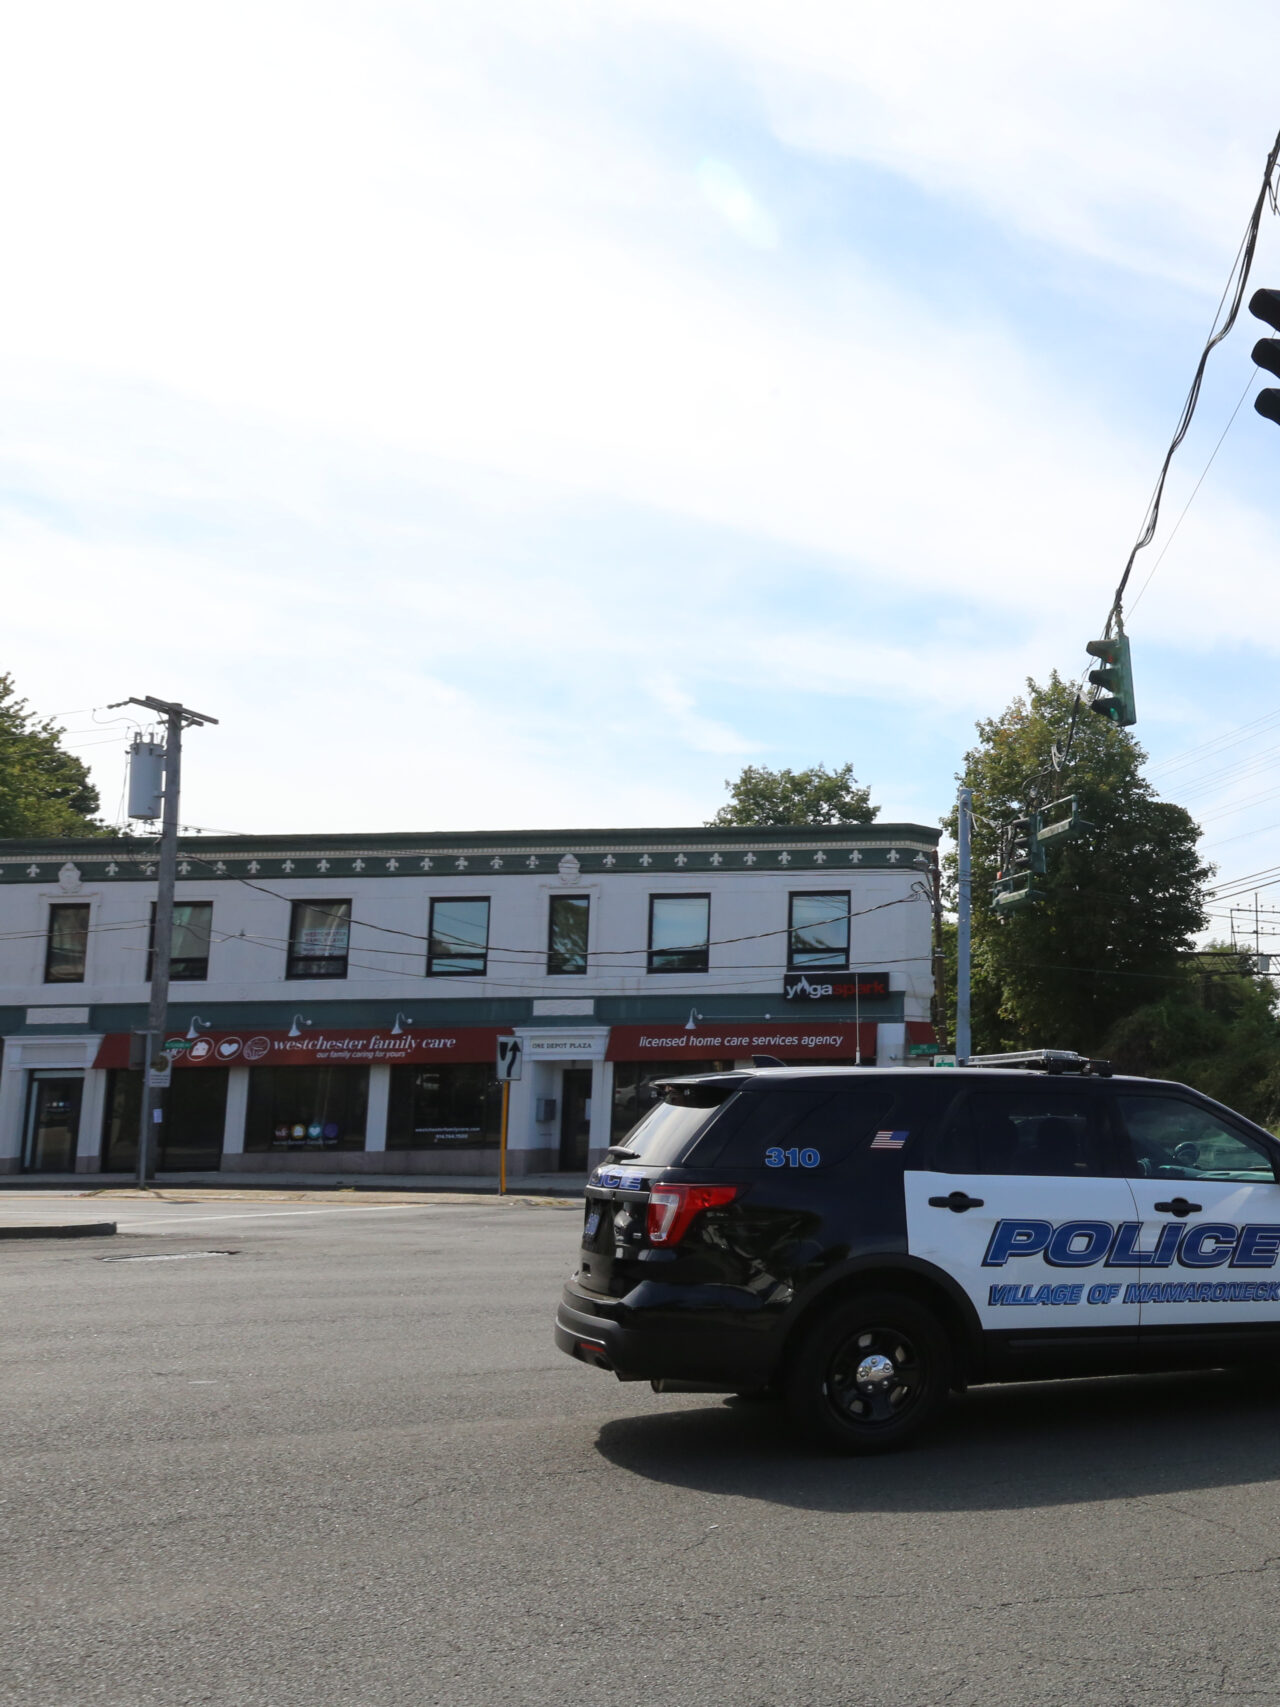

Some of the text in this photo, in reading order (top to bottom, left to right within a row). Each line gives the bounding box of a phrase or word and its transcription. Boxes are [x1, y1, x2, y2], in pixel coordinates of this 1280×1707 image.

[273, 1035, 456, 1050] westchester family care
[639, 1035, 843, 1048] licensed home care services agency
[329, 1050, 351, 1059] family
[352, 1050, 373, 1059] caring
[375, 1050, 385, 1058] for
[385, 1051, 406, 1059] yours
[765, 1147, 820, 1168] 310
[988, 1283, 1085, 1306] VILLAGE
[1086, 1282, 1122, 1304] OF
